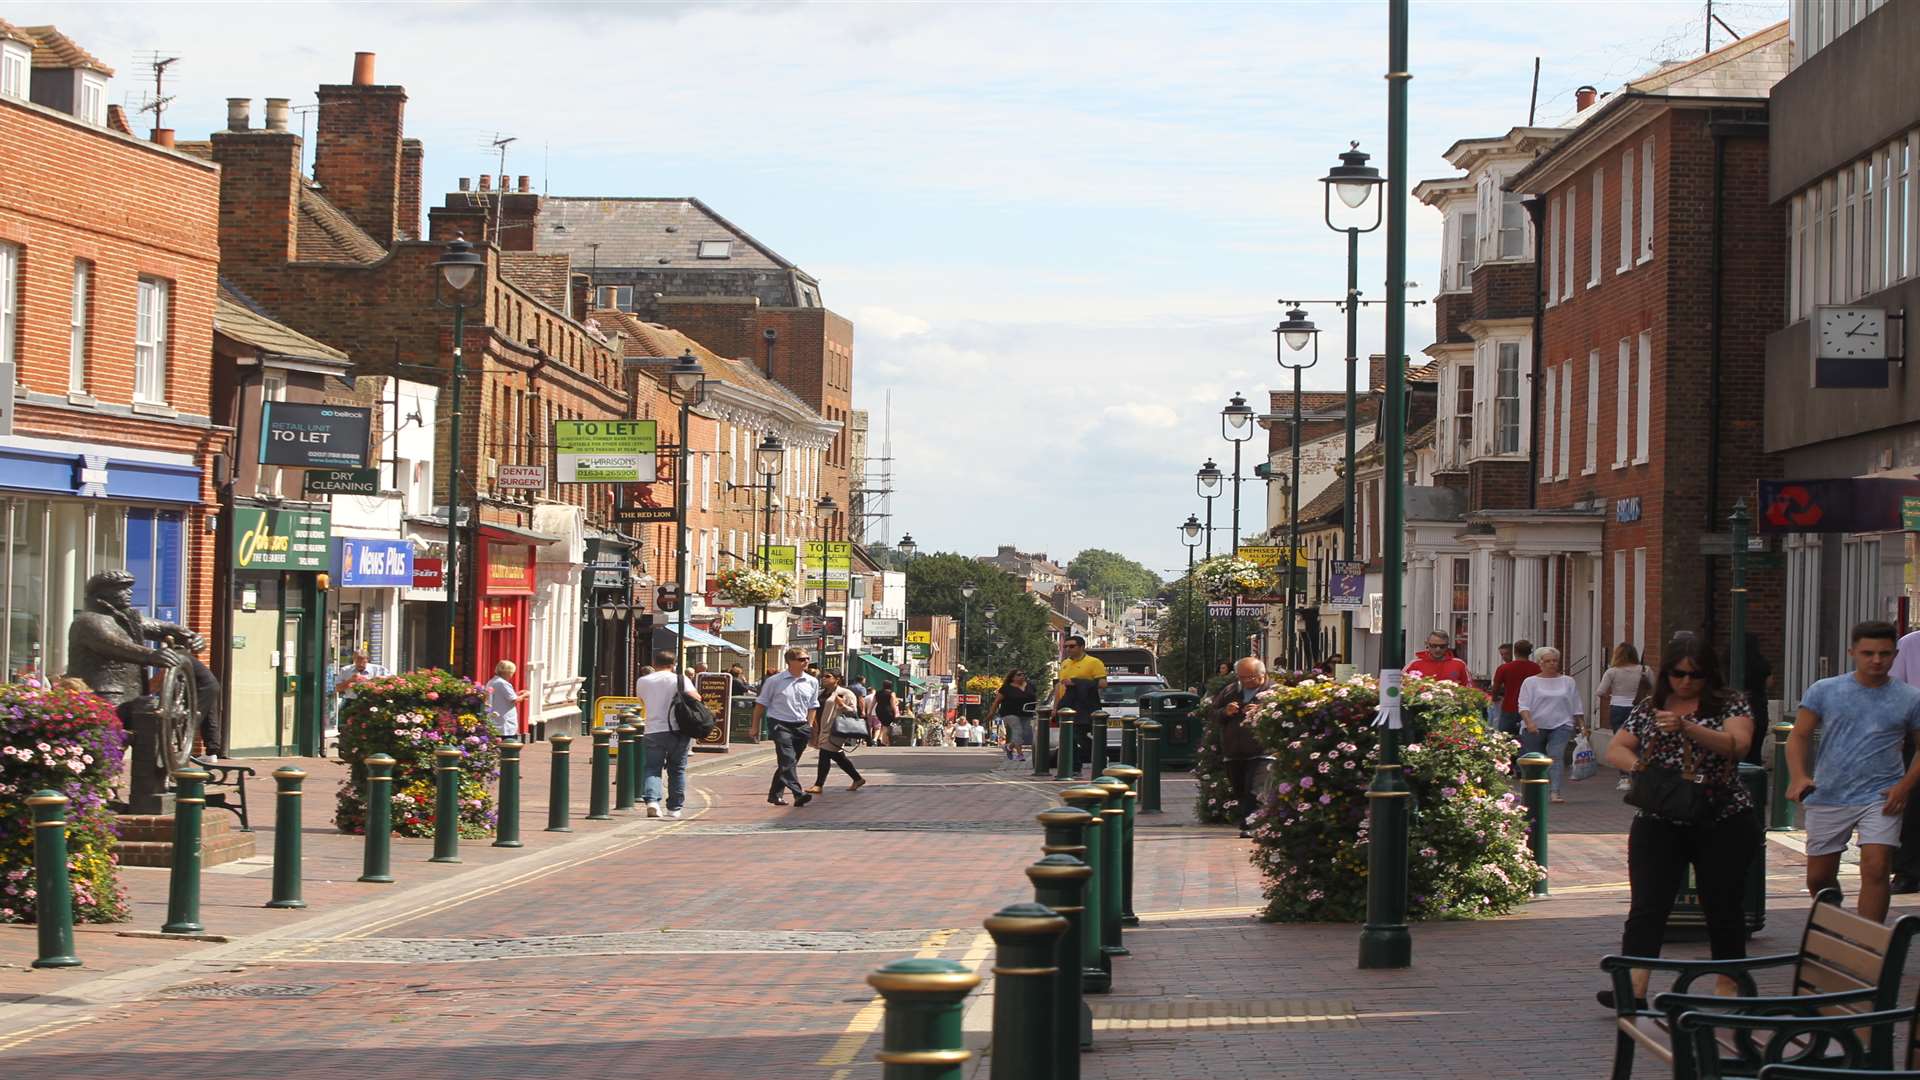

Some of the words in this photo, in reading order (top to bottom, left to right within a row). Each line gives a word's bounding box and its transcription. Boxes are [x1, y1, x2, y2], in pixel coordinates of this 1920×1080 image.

[272, 422, 306, 431] RETAIL
[307, 424, 332, 432] UNIT
[572, 422, 598, 435] TO
[606, 422, 639, 436] LET
[272, 429, 295, 441] TO
[299, 431, 331, 444] LET
[591, 457, 637, 466] HARRISONS
[330, 471, 354, 480] DRY
[503, 468, 541, 476] DENTAL
[311, 480, 373, 492] CLEANING
[500, 478, 542, 486] SURGERY
[620, 511, 636, 519] THE
[809, 543, 823, 552] TO
[827, 544, 848, 553] LET
[359, 545, 385, 576] News
[385, 546, 406, 576] Plus
